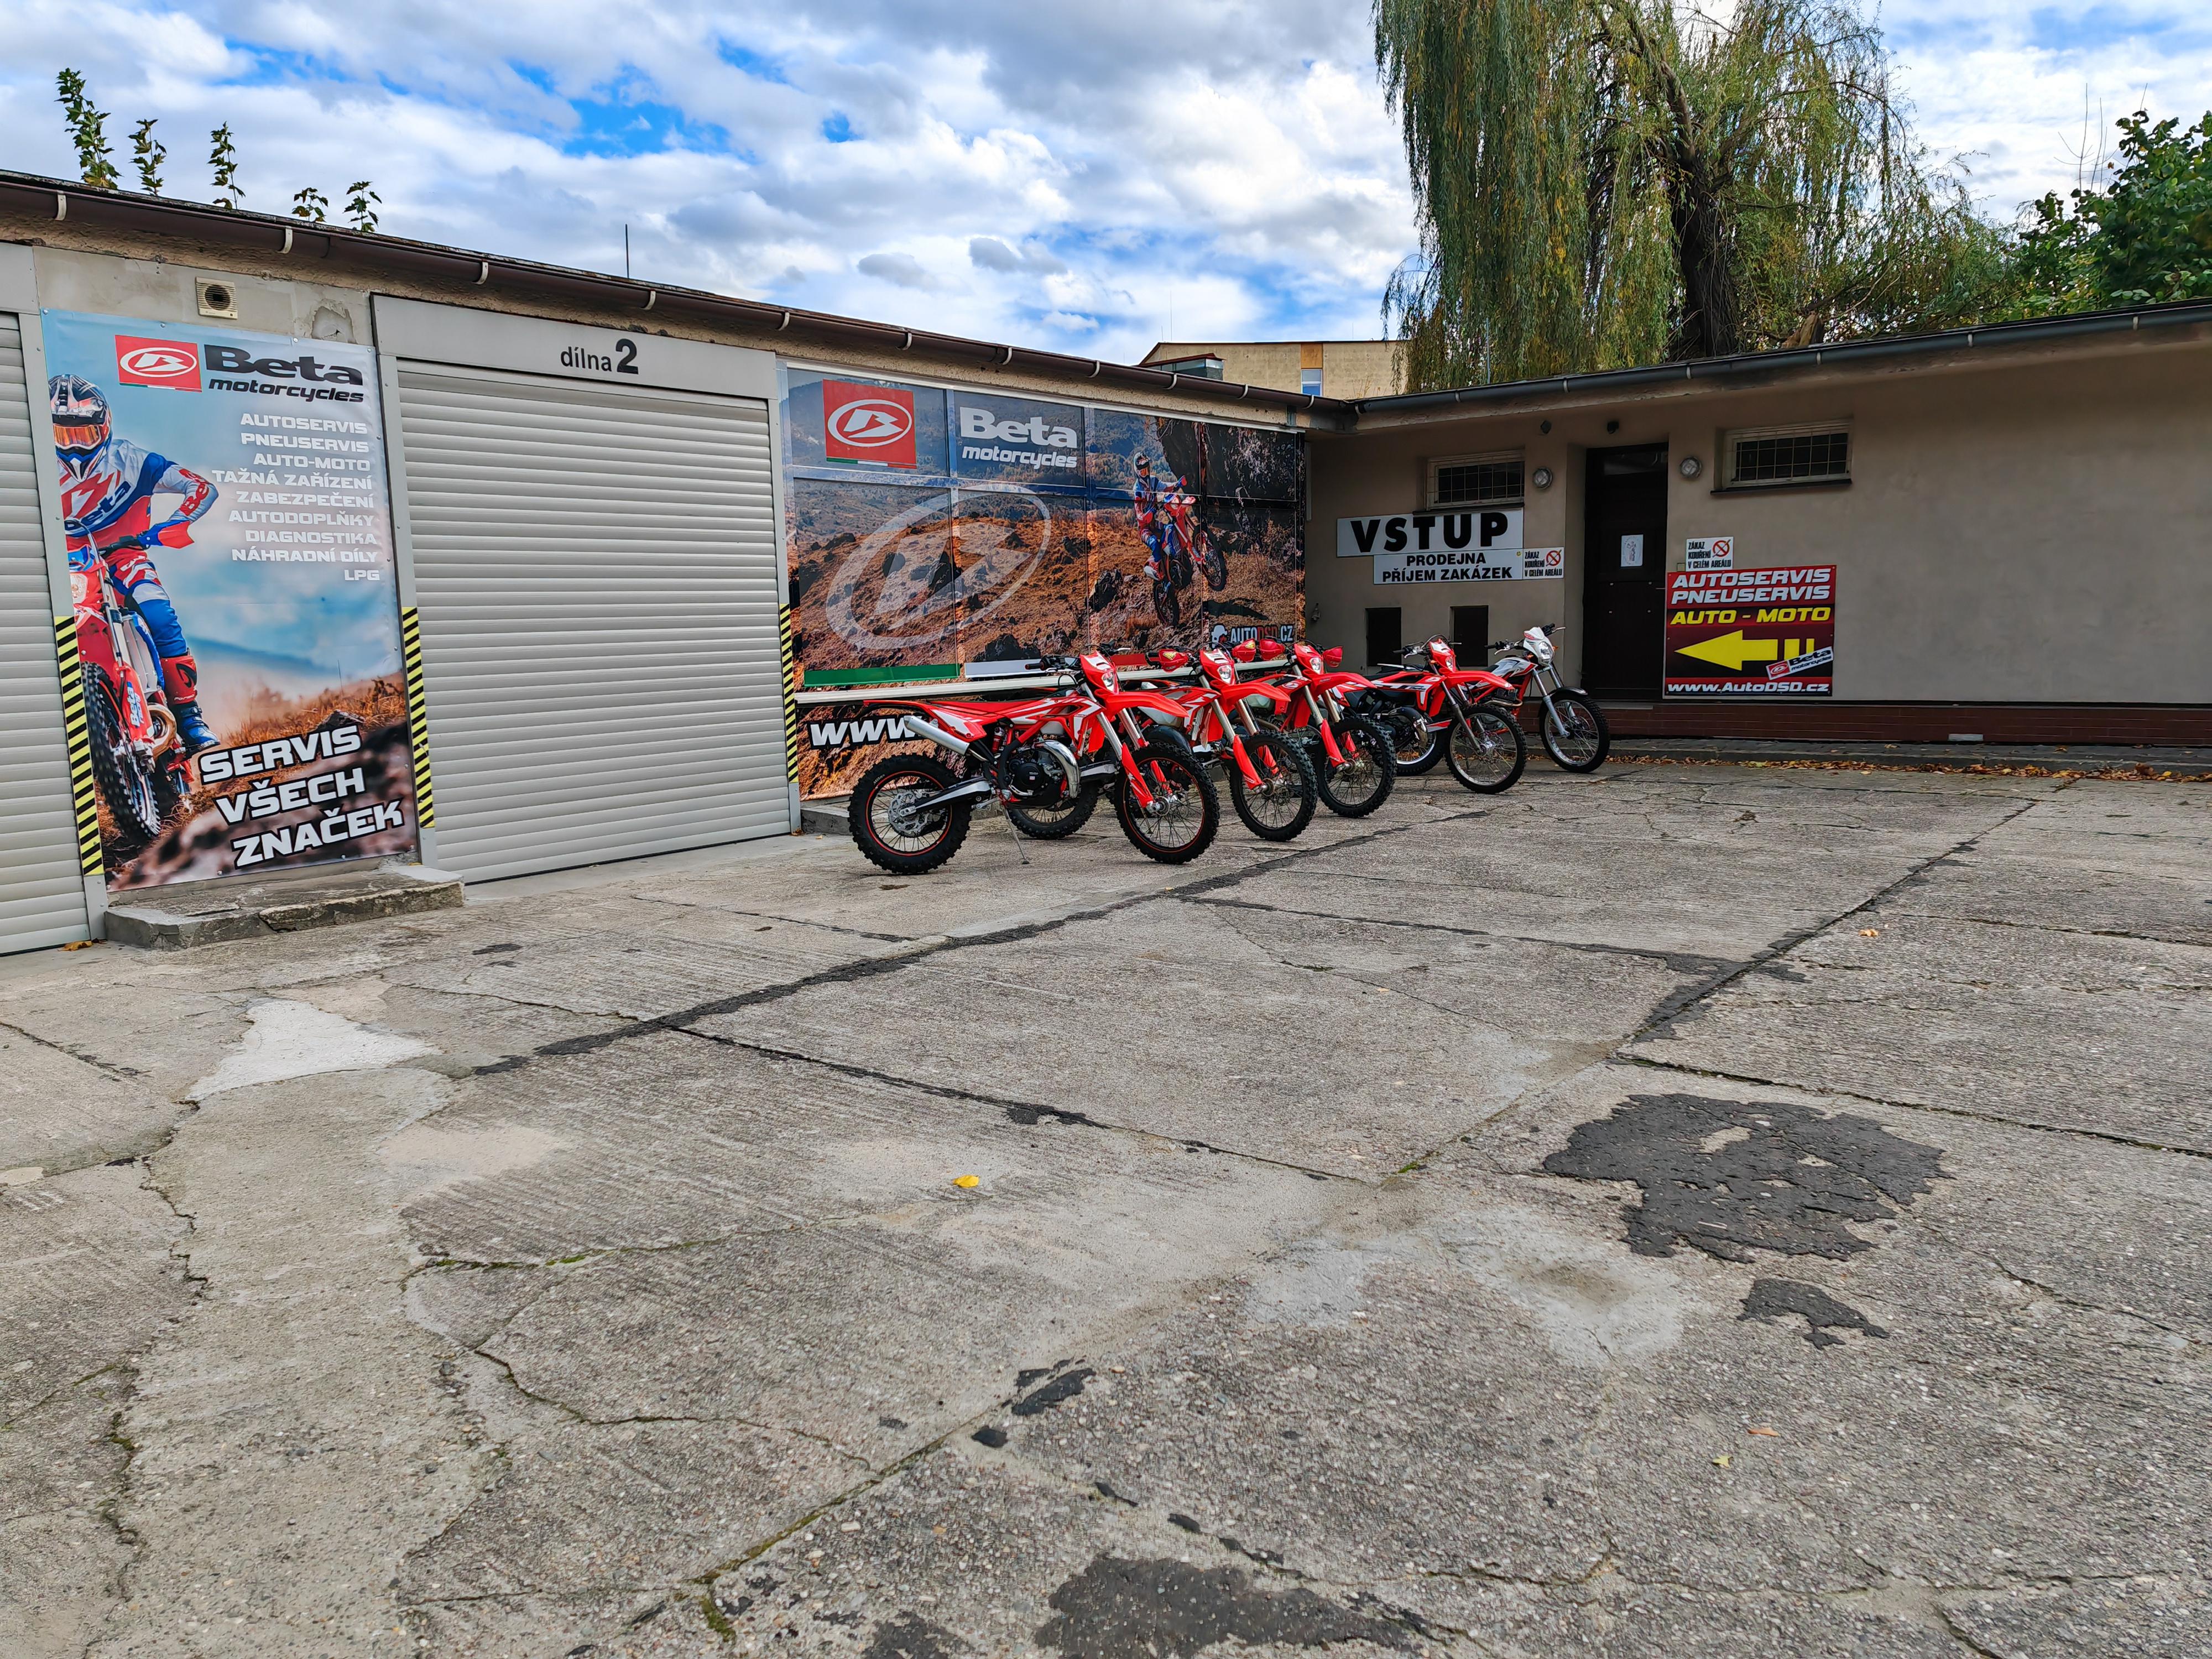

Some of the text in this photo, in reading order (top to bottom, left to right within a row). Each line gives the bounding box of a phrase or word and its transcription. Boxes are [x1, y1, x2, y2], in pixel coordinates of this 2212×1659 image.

[204, 344, 363, 386] Beta
[560, 338, 639, 375] dílna 2
[208, 378, 364, 403] motorcycles
[240, 413, 368, 435] AUTOSERVIS
[959, 406, 1078, 448] Beta
[240, 432, 369, 453] PNEUSERVIS
[253, 452, 371, 471] AUTO-MOTO
[961, 445, 1078, 470] motorcycles
[212, 467, 372, 490] TAŽNÁ ZAŘÍZENÍ
[236, 491, 374, 508] ZABEZPEČENÍ
[228, 510, 374, 526] AUTODOPLŇKY
[244, 529, 378, 545] DIAGNOSTIKA
[1350, 512, 1509, 553] VSTUP
[231, 545, 378, 563] NÁHRADNÍ DÍLY
[1525, 551, 1540, 559] ZÁKAZ
[1688, 541, 1705, 550] ZÁKAZ
[1406, 552, 1486, 566] PRODEJNA
[343, 569, 380, 581] LPG
[1383, 566, 1512, 582] PŘÍJEM ZAKÁZEK
[1671, 568, 1831, 589] AUTOSERVIS
[1671, 585, 1830, 604] PNEUSERVIS
[1670, 609, 1738, 625] AUTO
[1756, 607, 1831, 623] MOTO
[1788, 650, 1831, 666] Beta
[1791, 656, 1832, 671] motorcycles
[1667, 682, 1829, 692] www.AutoDSD.cz
[200, 726, 361, 783] SERVIS
[216, 768, 366, 825] VŠECH
[233, 799, 404, 868] ZNAČEK
